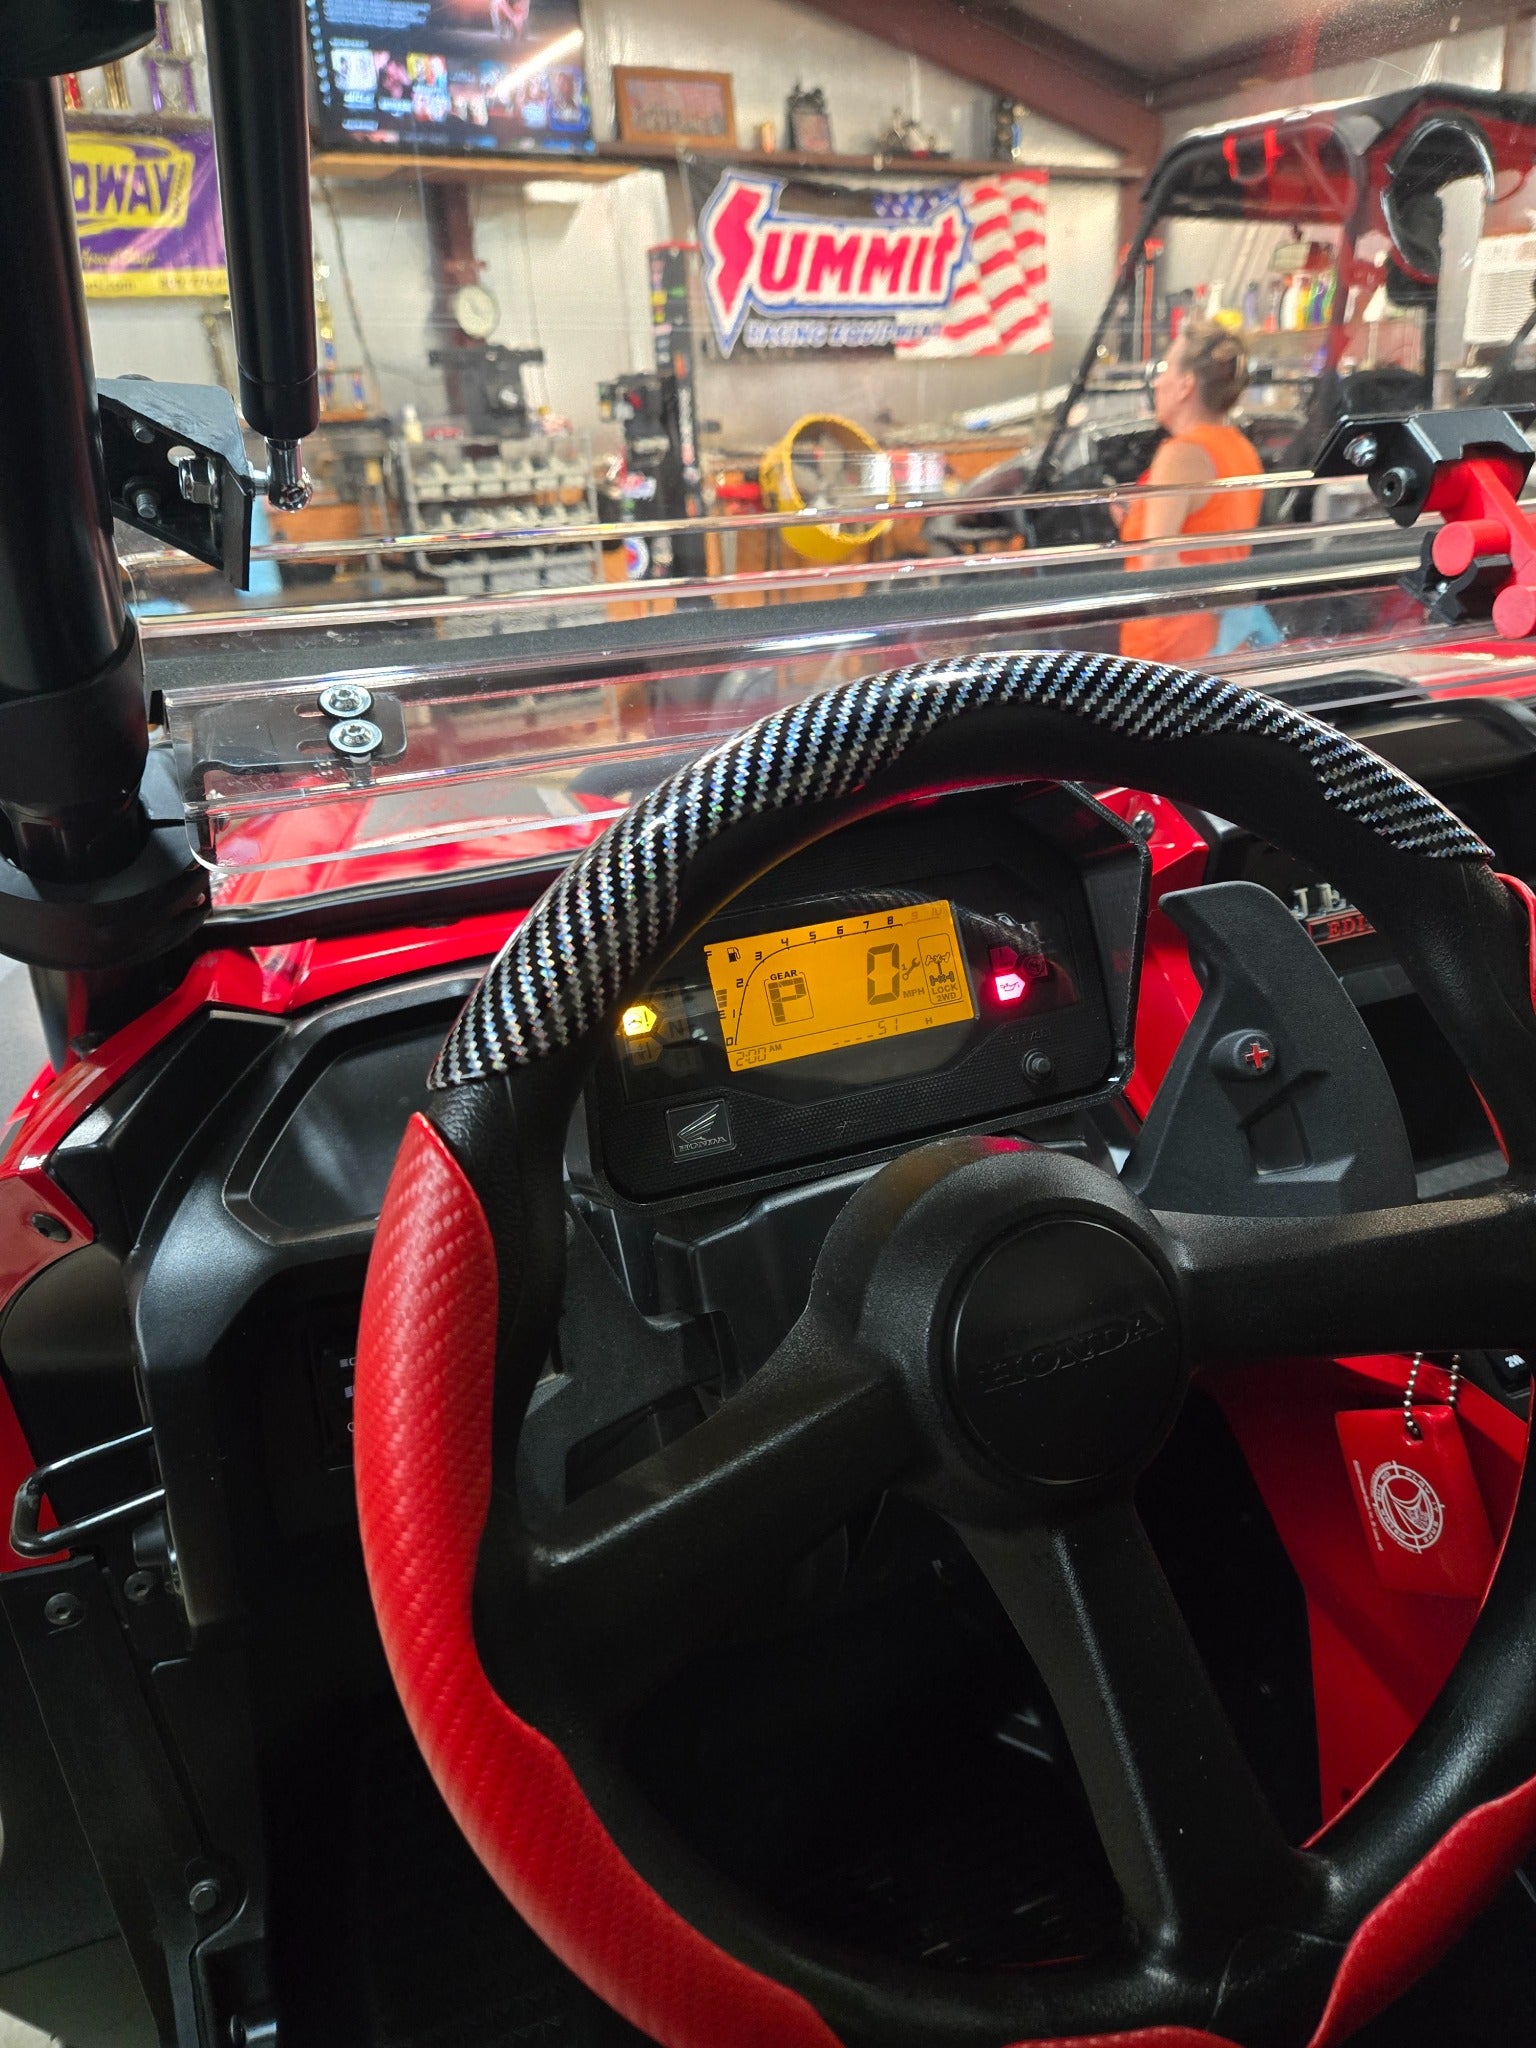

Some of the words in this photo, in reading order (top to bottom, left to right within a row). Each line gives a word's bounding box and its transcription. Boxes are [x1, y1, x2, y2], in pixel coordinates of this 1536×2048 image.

[863, 920, 870, 929] 7
[887, 916, 894, 924] 8
[836, 925, 844, 935] 6
[809, 931, 816, 940] 5
[781, 937, 789, 946] 4
[755, 951, 762, 960] 3
[770, 969, 798, 981] GEAR
[867, 942, 900, 1005] 0
[736, 978, 744, 988] 2
[902, 987, 926, 999] MPH
[931, 982, 958, 995] LOCK
[767, 977, 807, 1023] P
[936, 992, 957, 1002] 2WD
[736, 1047, 767, 1066] 2:00
[769, 1043, 783, 1053] AM
